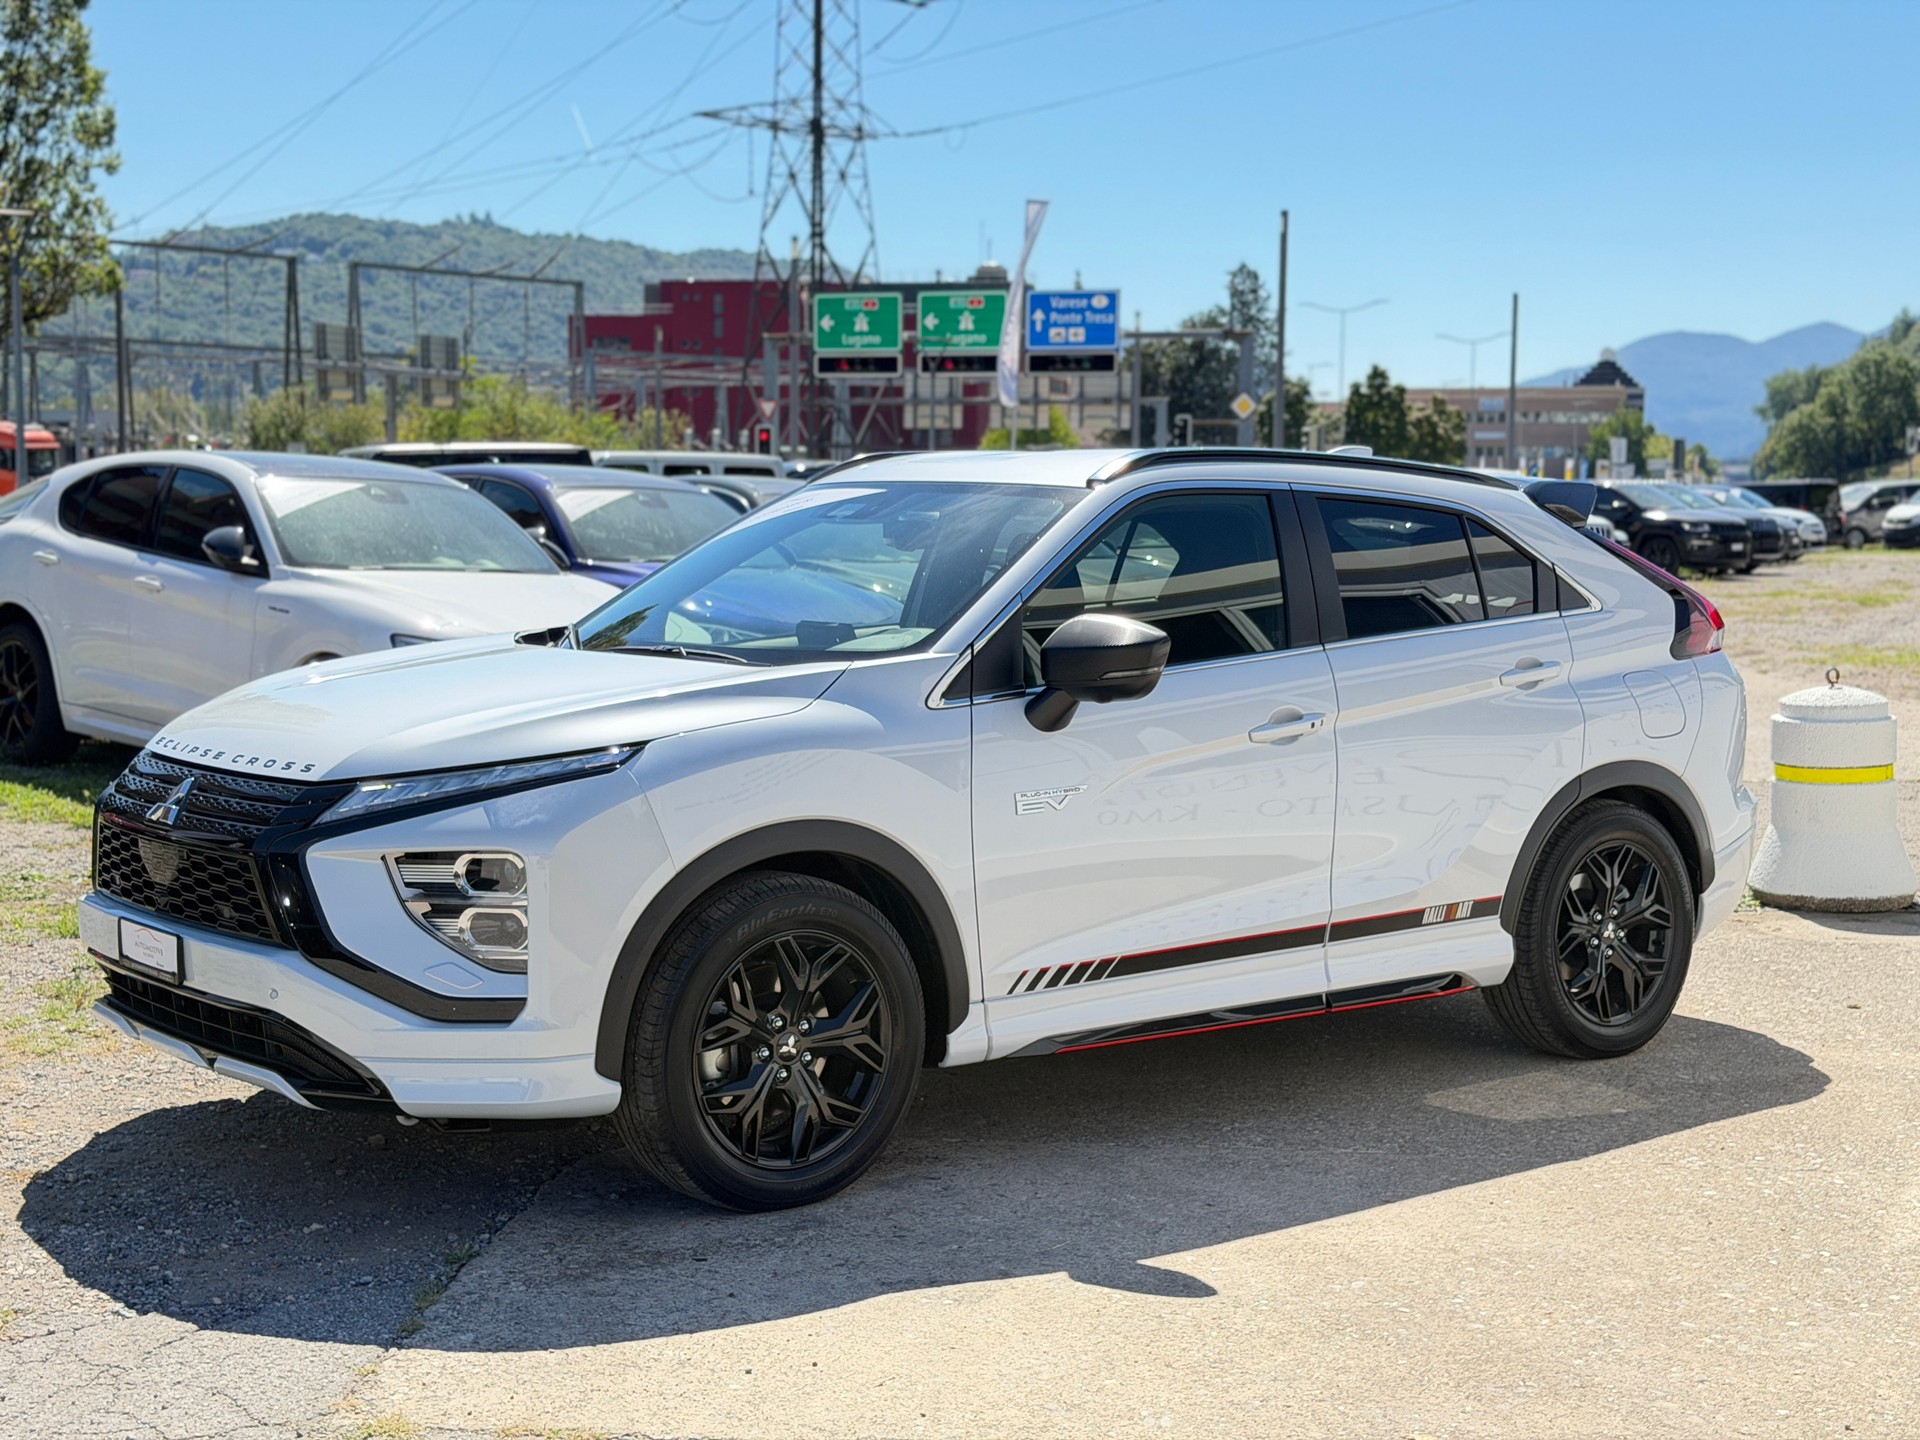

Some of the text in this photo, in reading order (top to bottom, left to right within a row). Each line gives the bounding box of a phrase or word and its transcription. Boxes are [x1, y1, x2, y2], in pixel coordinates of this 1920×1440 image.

[1049, 295, 1088, 308] Varese
[1049, 310, 1115, 324] Ponte Tresa
[841, 334, 882, 349] Lugano
[155, 736, 316, 773] ECLIPSE CROSS
[1052, 787, 1081, 795] HYBRID
[1015, 795, 1072, 815] EV
